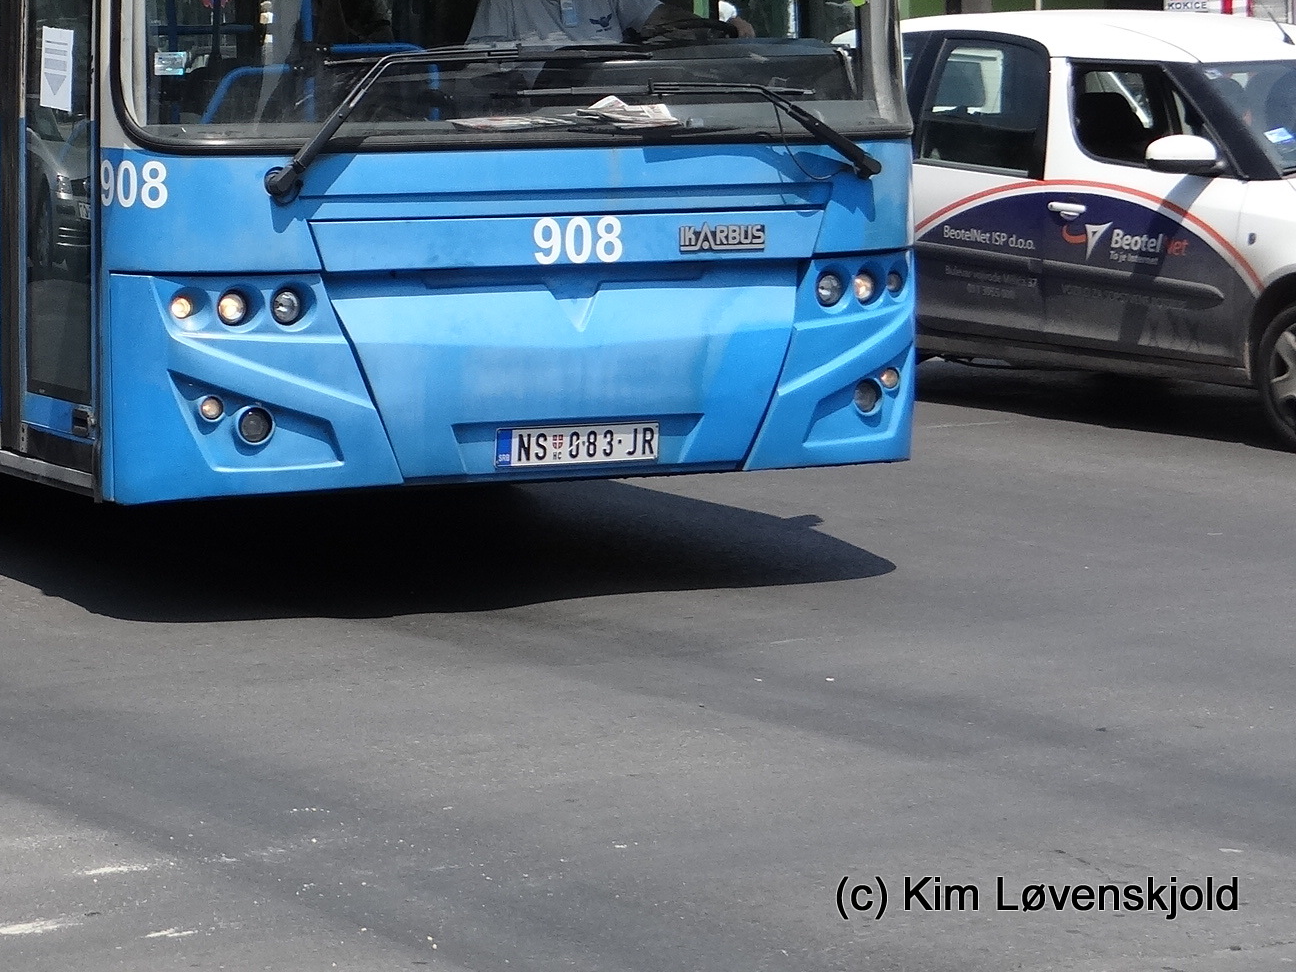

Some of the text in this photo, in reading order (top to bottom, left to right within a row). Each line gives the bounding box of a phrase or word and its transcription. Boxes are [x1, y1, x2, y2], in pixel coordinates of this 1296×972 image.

[1167, 1, 1207, 10] KOKICE
[100, 159, 168, 208] 908
[533, 215, 623, 265] 908
[679, 222, 765, 251] IKARBUS
[943, 225, 991, 244] BeotelNet
[991, 231, 1007, 245] ISP
[498, 454, 510, 462] SRB
[517, 432, 548, 462] NS
